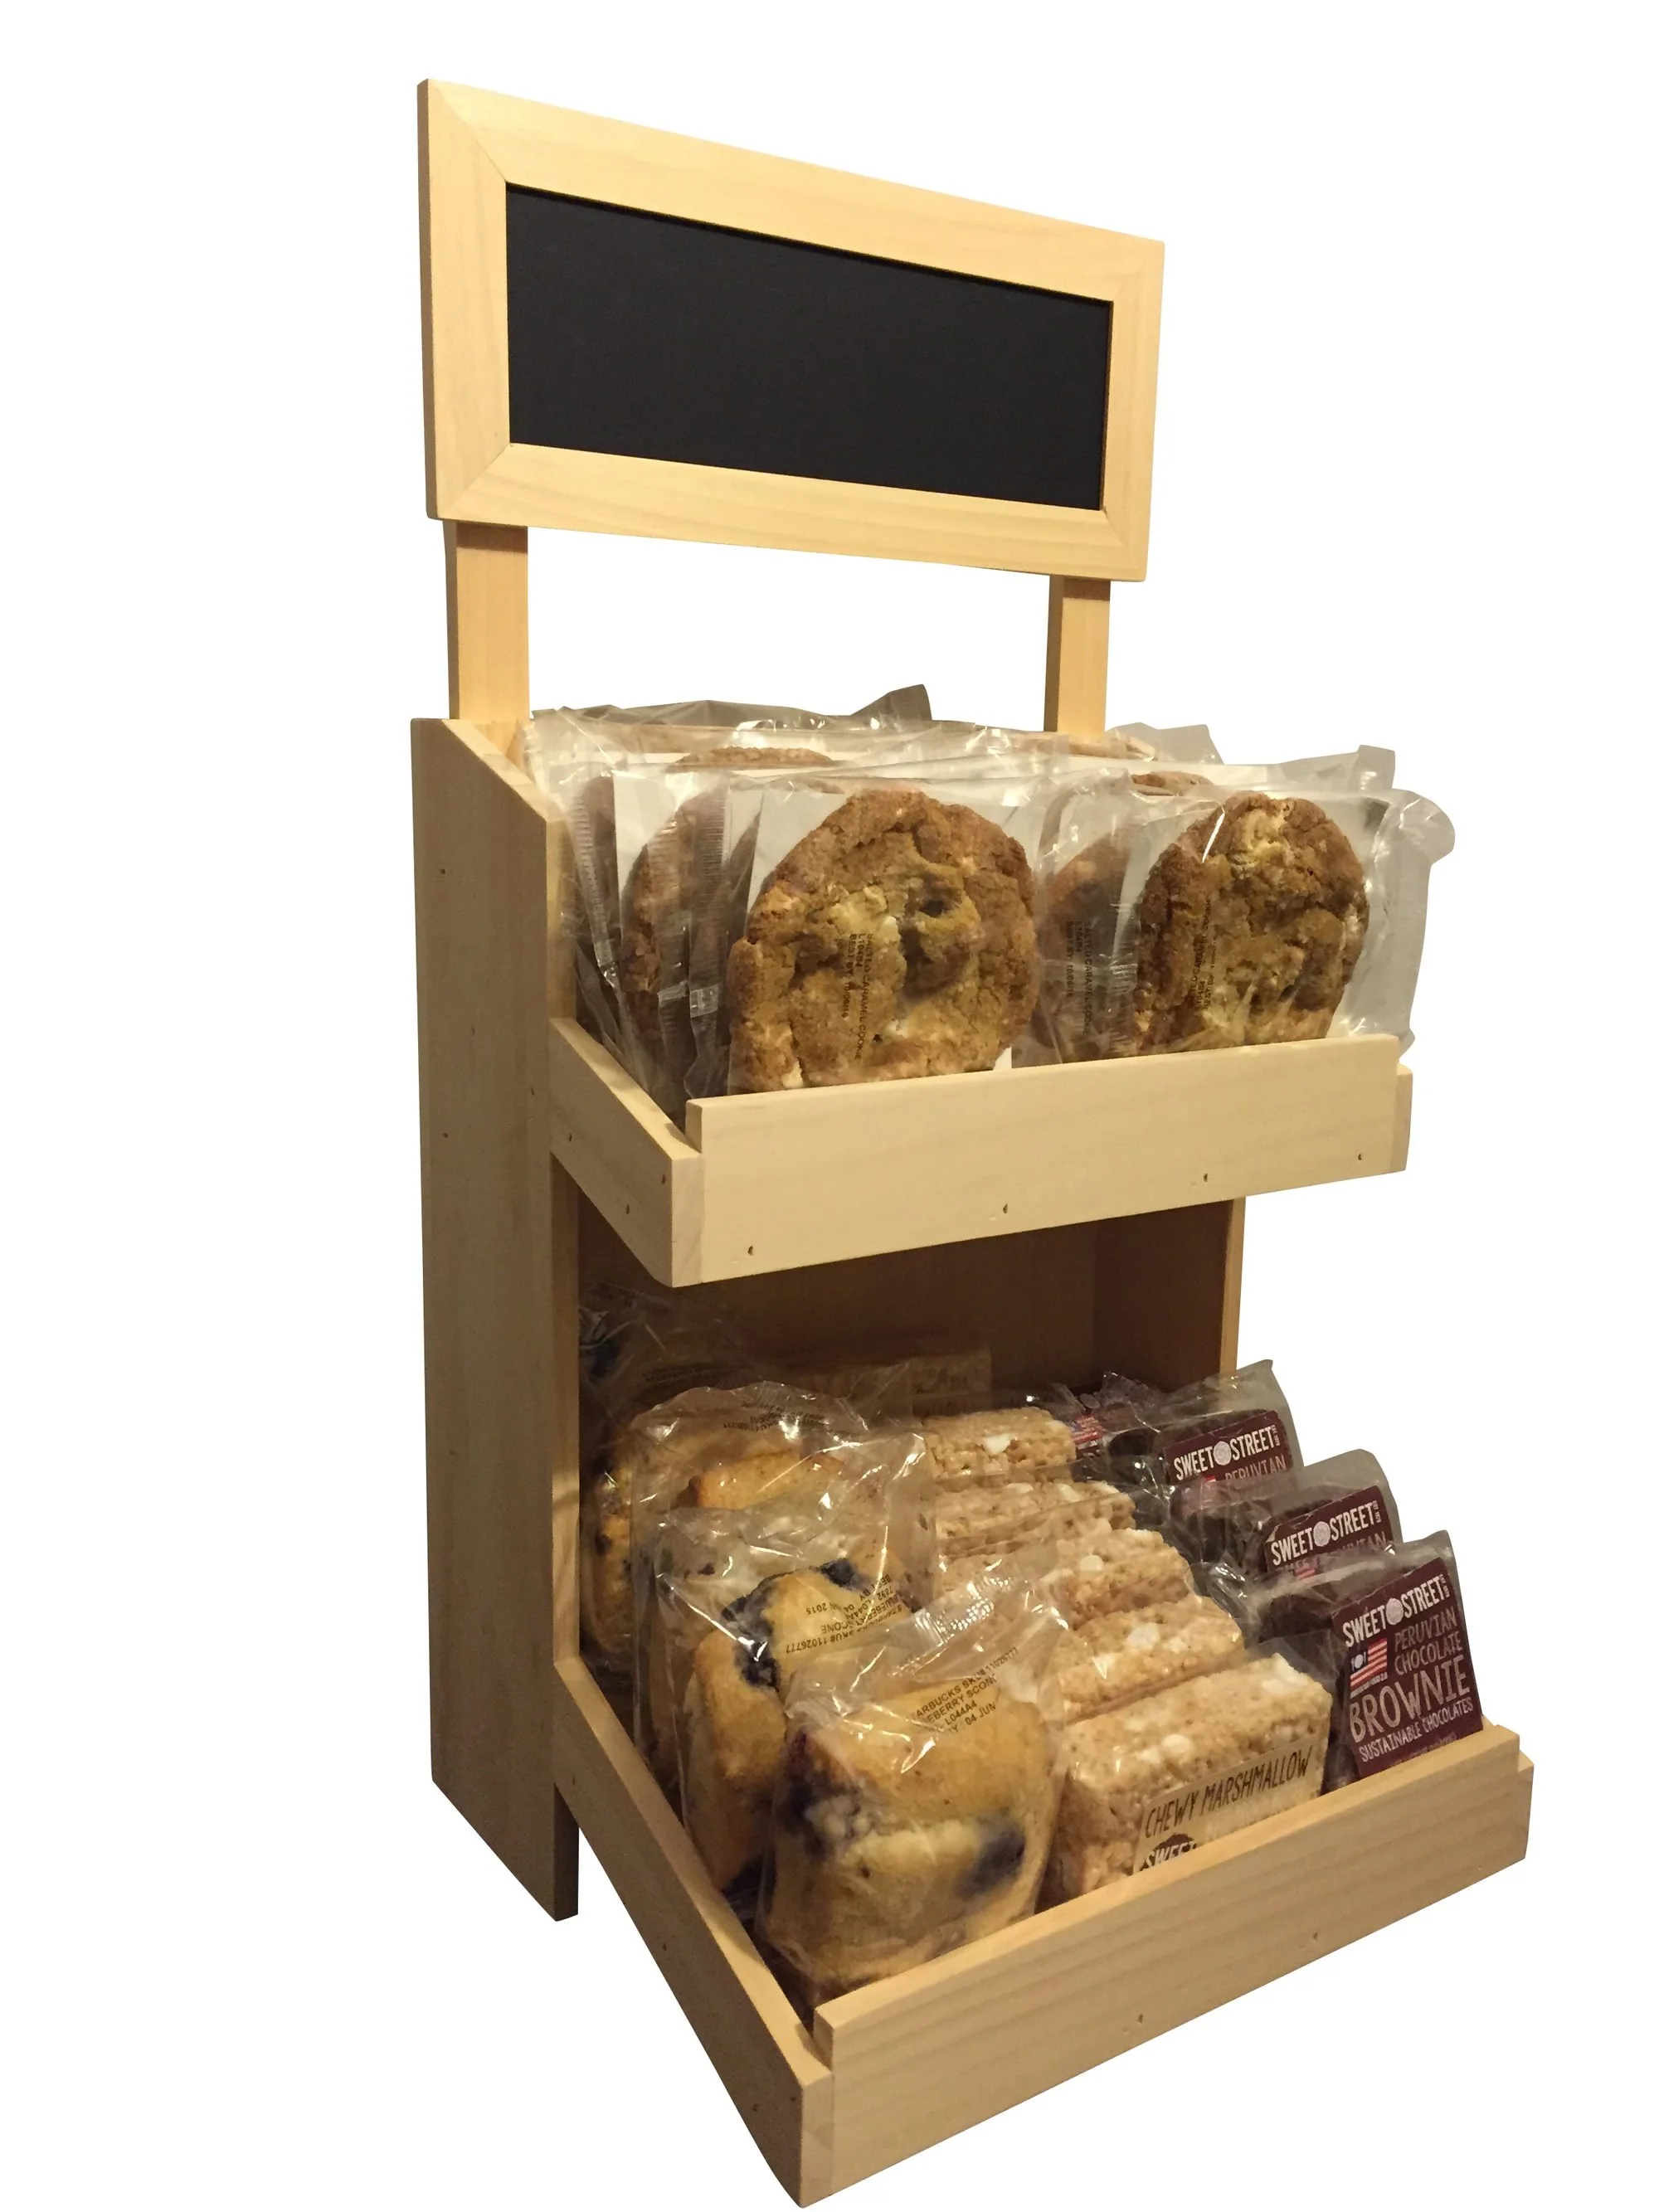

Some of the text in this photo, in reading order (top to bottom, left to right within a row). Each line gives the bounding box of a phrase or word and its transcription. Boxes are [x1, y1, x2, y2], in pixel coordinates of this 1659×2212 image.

[1174, 1446, 1214, 1481] SWEET
[1229, 1427, 1275, 1461] STREET
[1271, 1527, 1313, 1566] SWEET
[1330, 1502, 1375, 1541] STREET
[1342, 1605, 1387, 1648] SWEET
[1400, 1575, 1445, 1619] STREET
[1394, 1606, 1458, 1652] PERUVIAN
[1394, 1631, 1463, 1676] CHOCOLATE
[916, 1685, 961, 1717] ARBUCKS
[927, 1694, 964, 1723] EBERRY
[1350, 1654, 1470, 1743] BROWNIE
[1359, 1721, 1422, 1762] SUSTAINABLE
[1422, 1696, 1474, 1733] CHOCOLATES
[1146, 1745, 1313, 1839] CHEWY MARSHMALLOW
